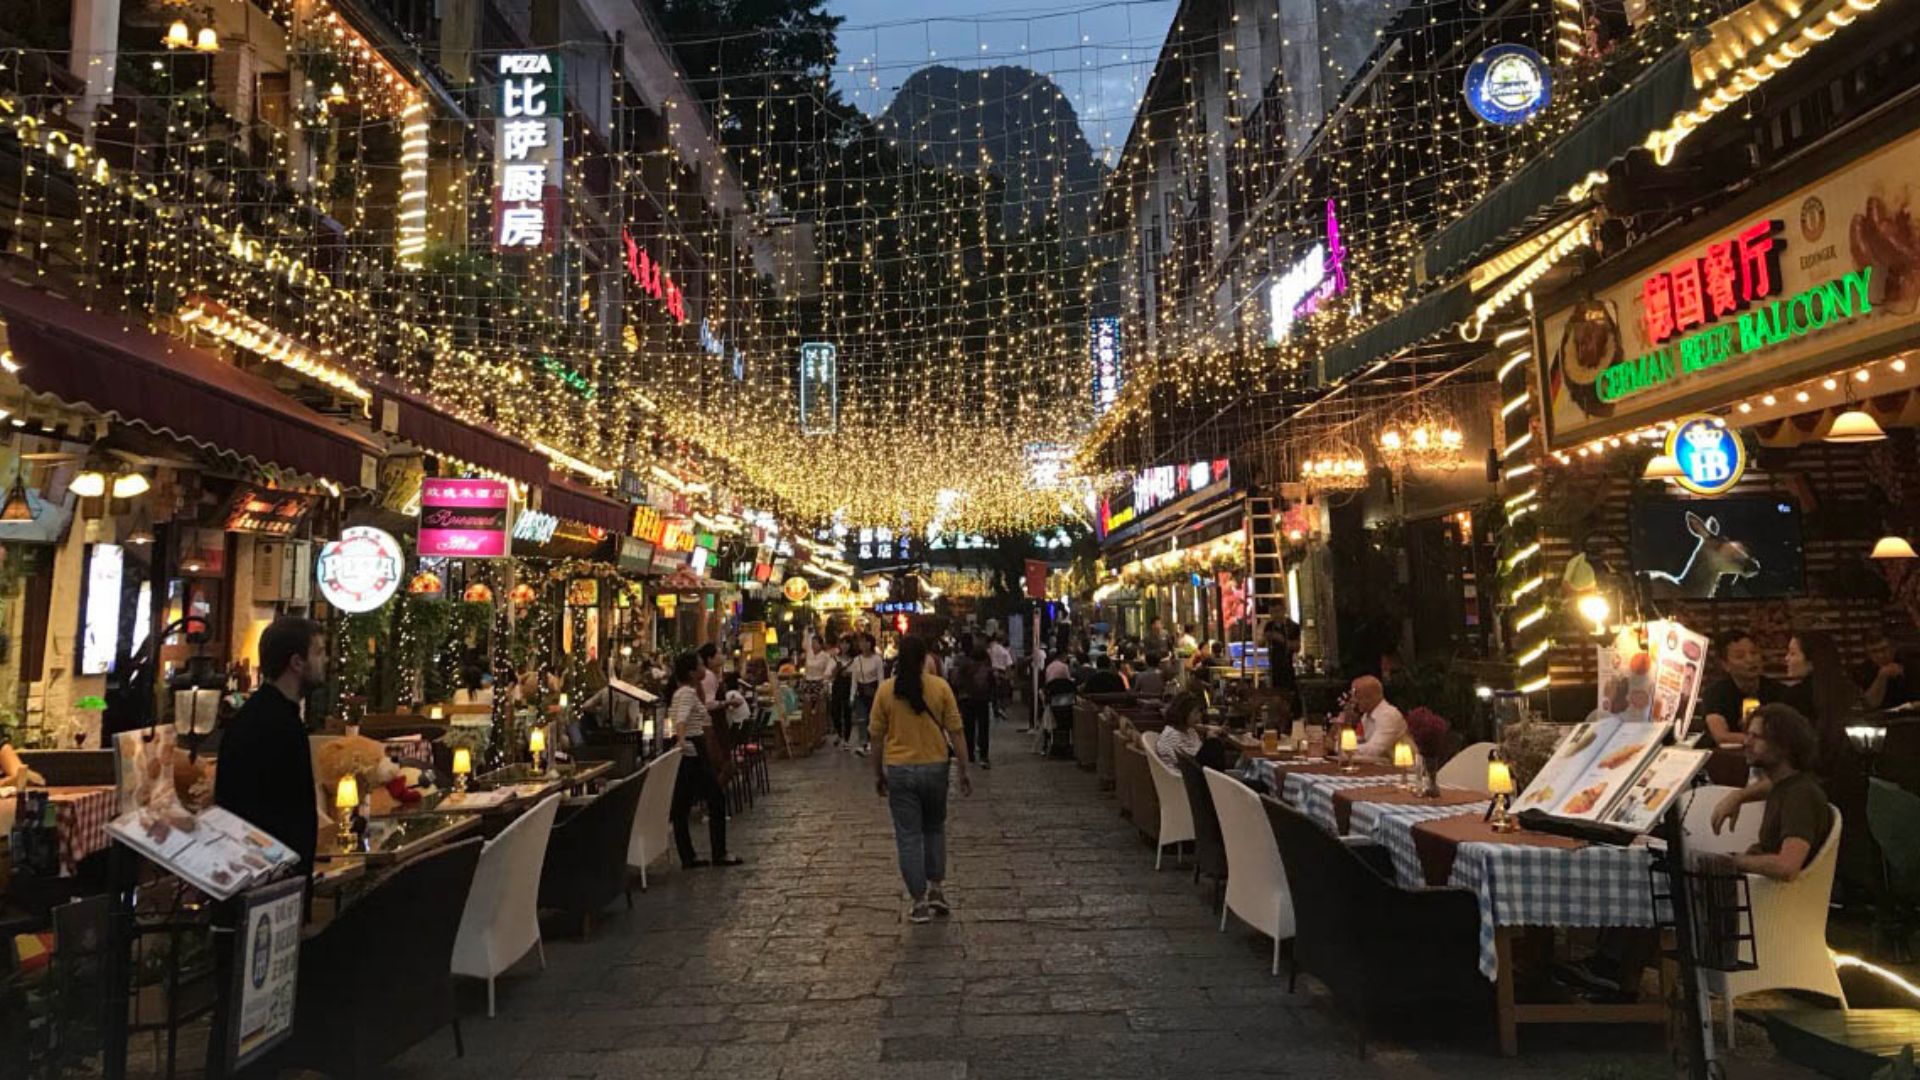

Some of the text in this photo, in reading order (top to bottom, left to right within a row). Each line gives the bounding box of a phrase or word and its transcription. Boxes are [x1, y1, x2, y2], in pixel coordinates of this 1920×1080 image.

[500, 55, 552, 73] PIZZA
[500, 77, 547, 246] 比萨厨房
[1595, 346, 1676, 402] GERMAN
[1738, 266, 1872, 353] BALCONY
[1642, 219, 1775, 346] 德国餐厅
